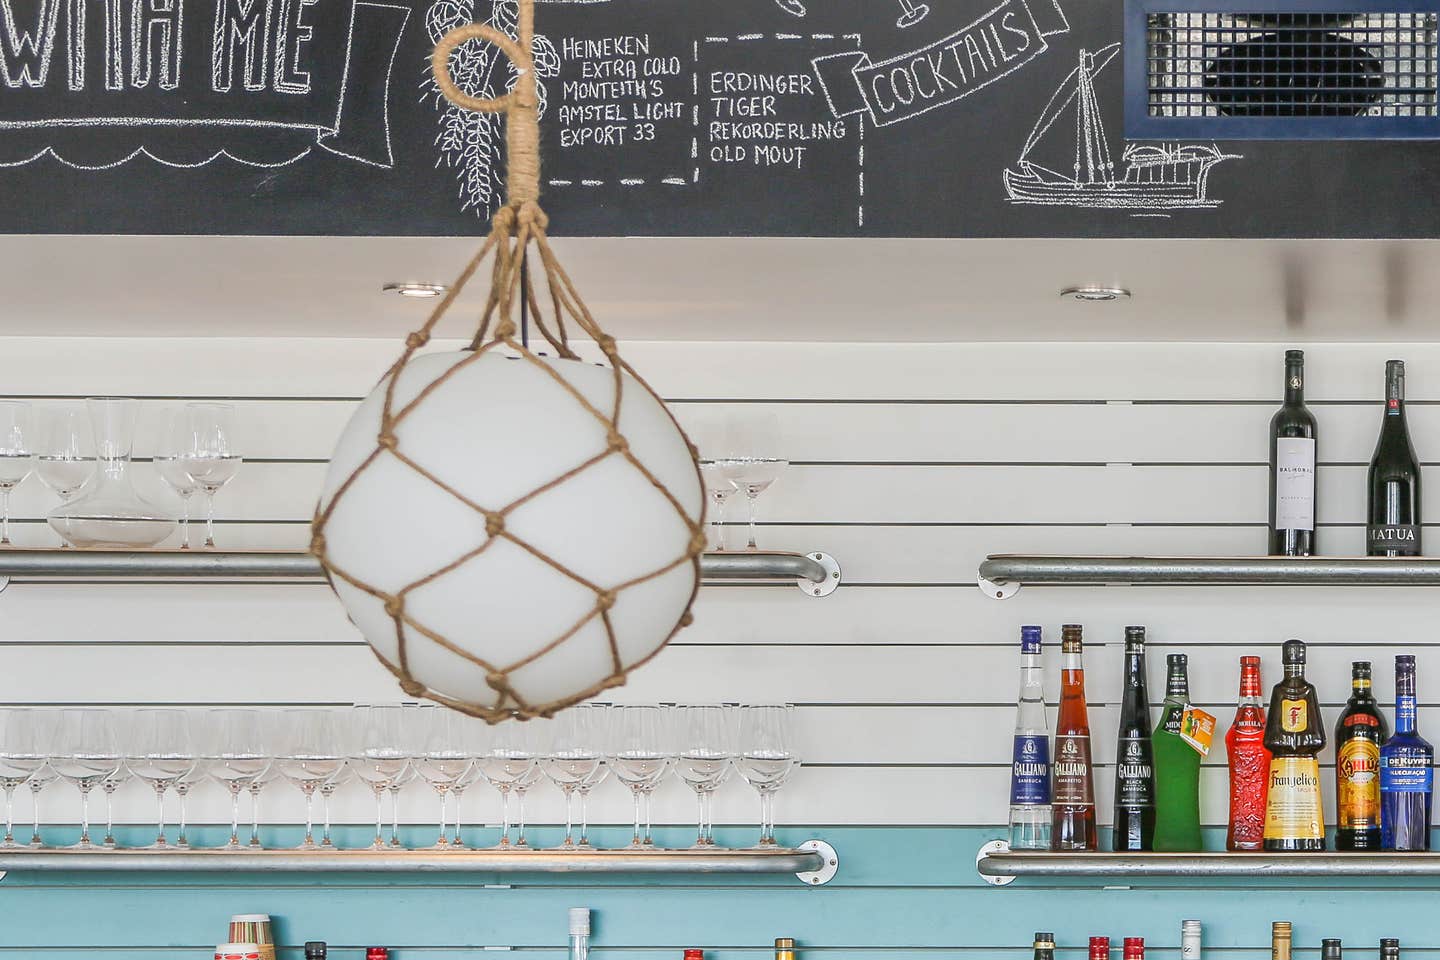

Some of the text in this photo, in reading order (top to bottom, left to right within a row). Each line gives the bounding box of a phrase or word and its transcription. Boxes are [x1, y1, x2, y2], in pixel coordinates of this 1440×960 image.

[212, 0, 314, 94] ME
[563, 37, 649, 60] HEINEKEN
[583, 56, 680, 78] EXTRA COLD
[872, 12, 1031, 114] COCKTAILS
[564, 77, 663, 99] MONTEITH'S
[711, 72, 814, 97] ERDINGER
[559, 99, 683, 123] AMSTEL LIGHT
[711, 96, 776, 116] TIGER
[561, 123, 655, 147] EXPORT 33
[710, 117, 845, 140] REKORDERLING
[711, 140, 806, 166] OLD MOUT
[1014, 761, 1047, 777] GALLIANO
[1054, 761, 1087, 777] GALLIANO
[1118, 763, 1151, 779] GALLIANO
[1269, 769, 1318, 788] Frangelico
